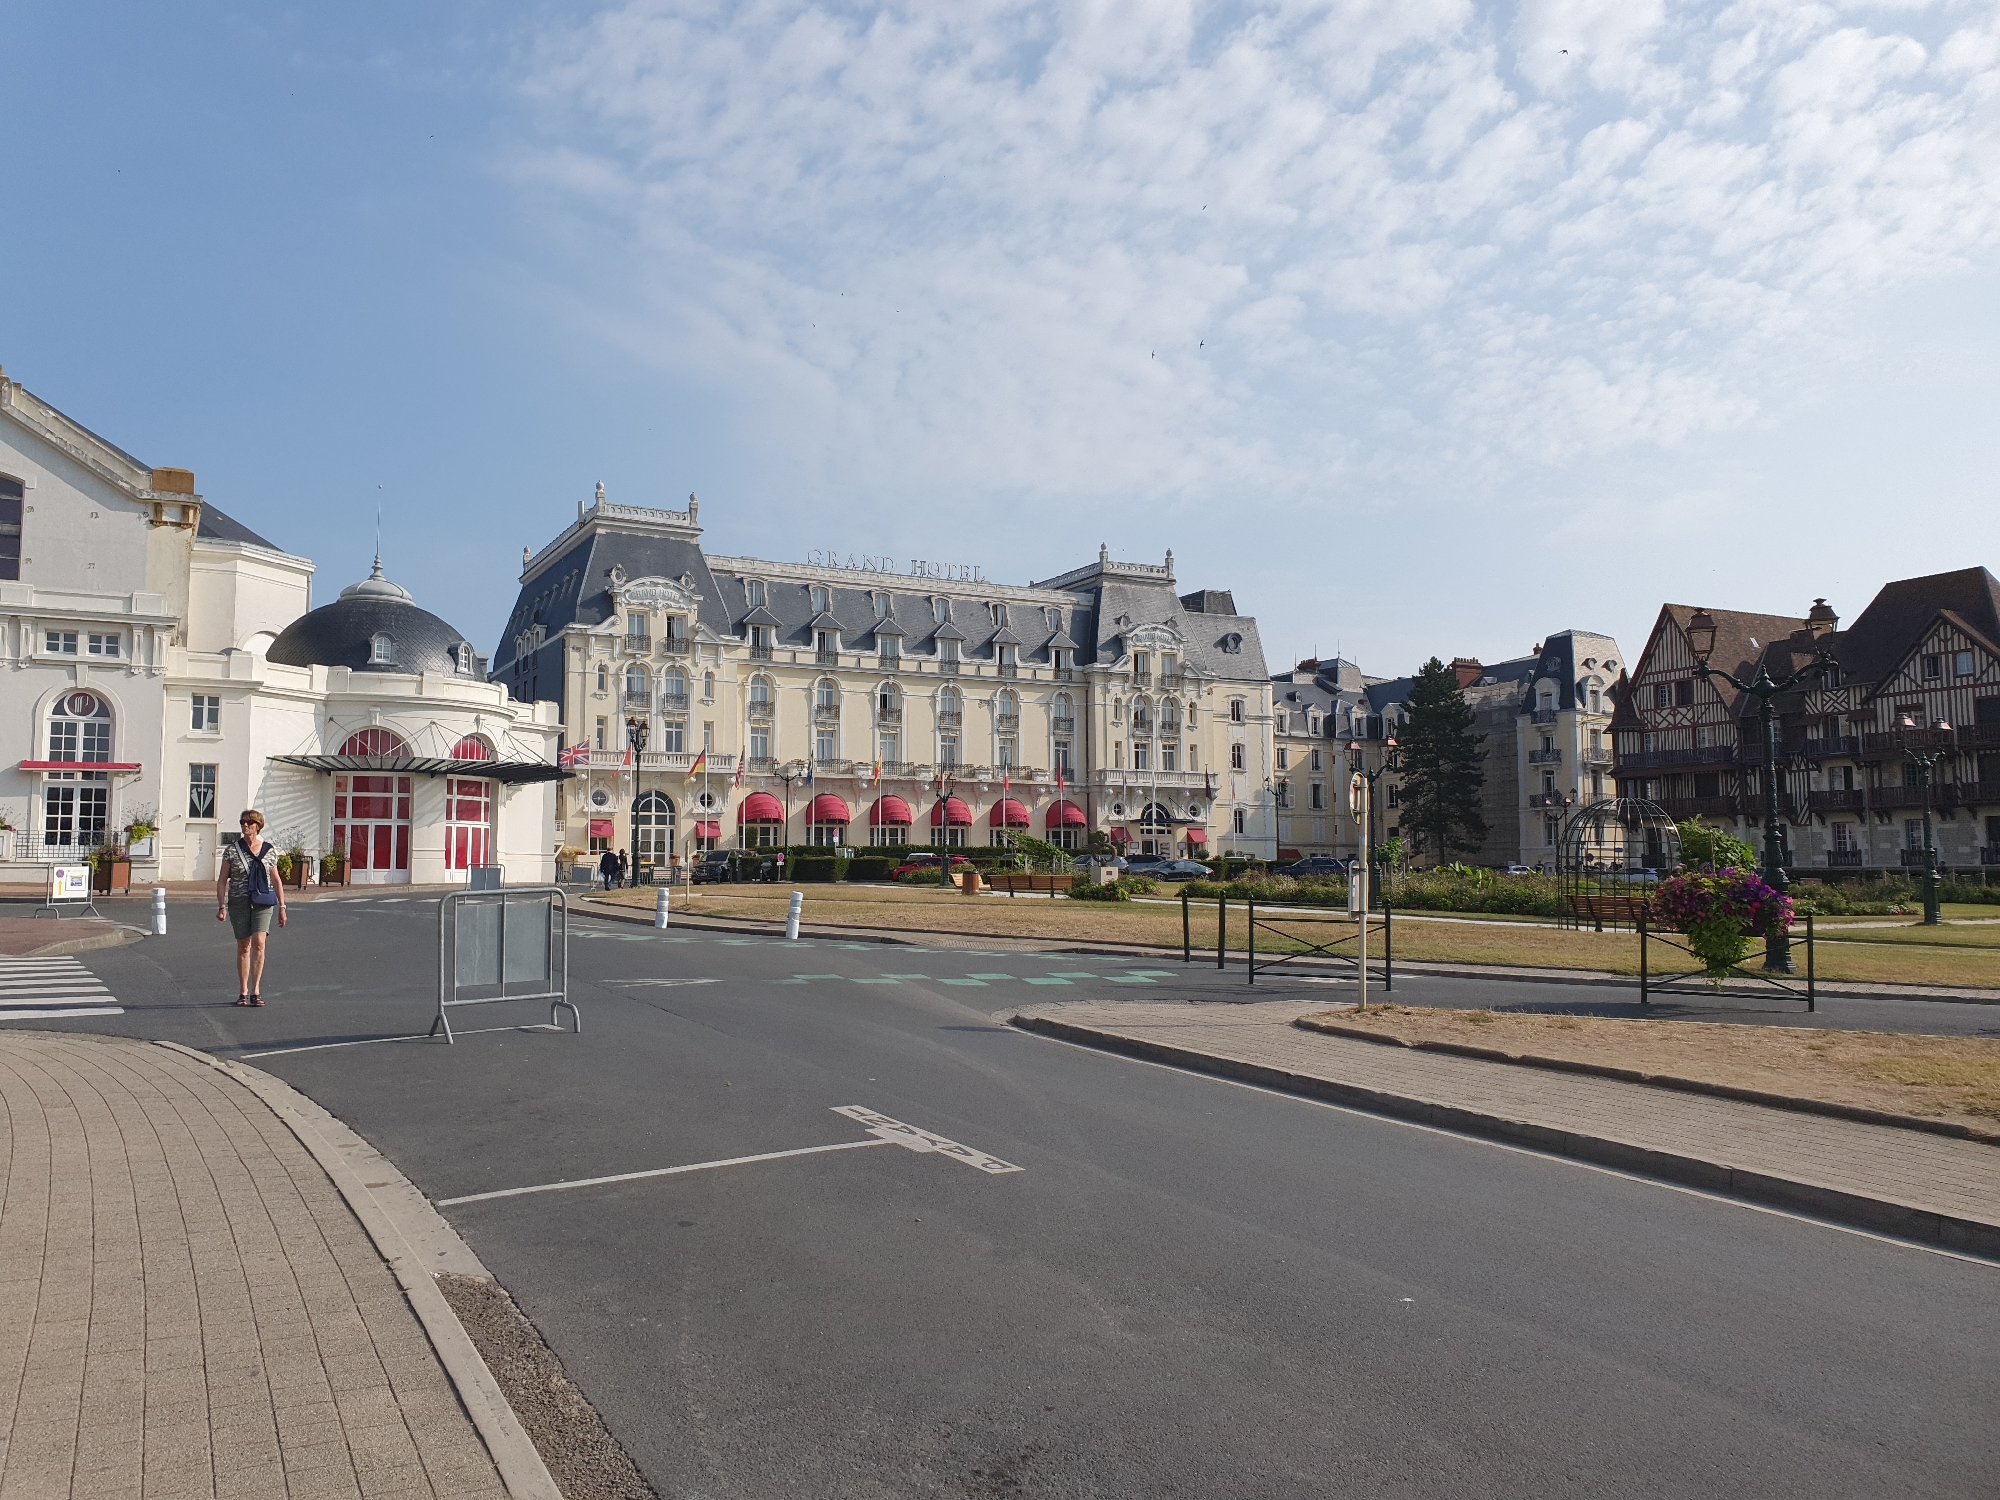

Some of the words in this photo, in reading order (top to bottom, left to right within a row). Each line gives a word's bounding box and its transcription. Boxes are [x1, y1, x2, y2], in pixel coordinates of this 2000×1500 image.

[807, 549, 897, 573] GRAND
[910, 559, 986, 582] HOTEL
[848, 1108, 1012, 1170] PAYANT
